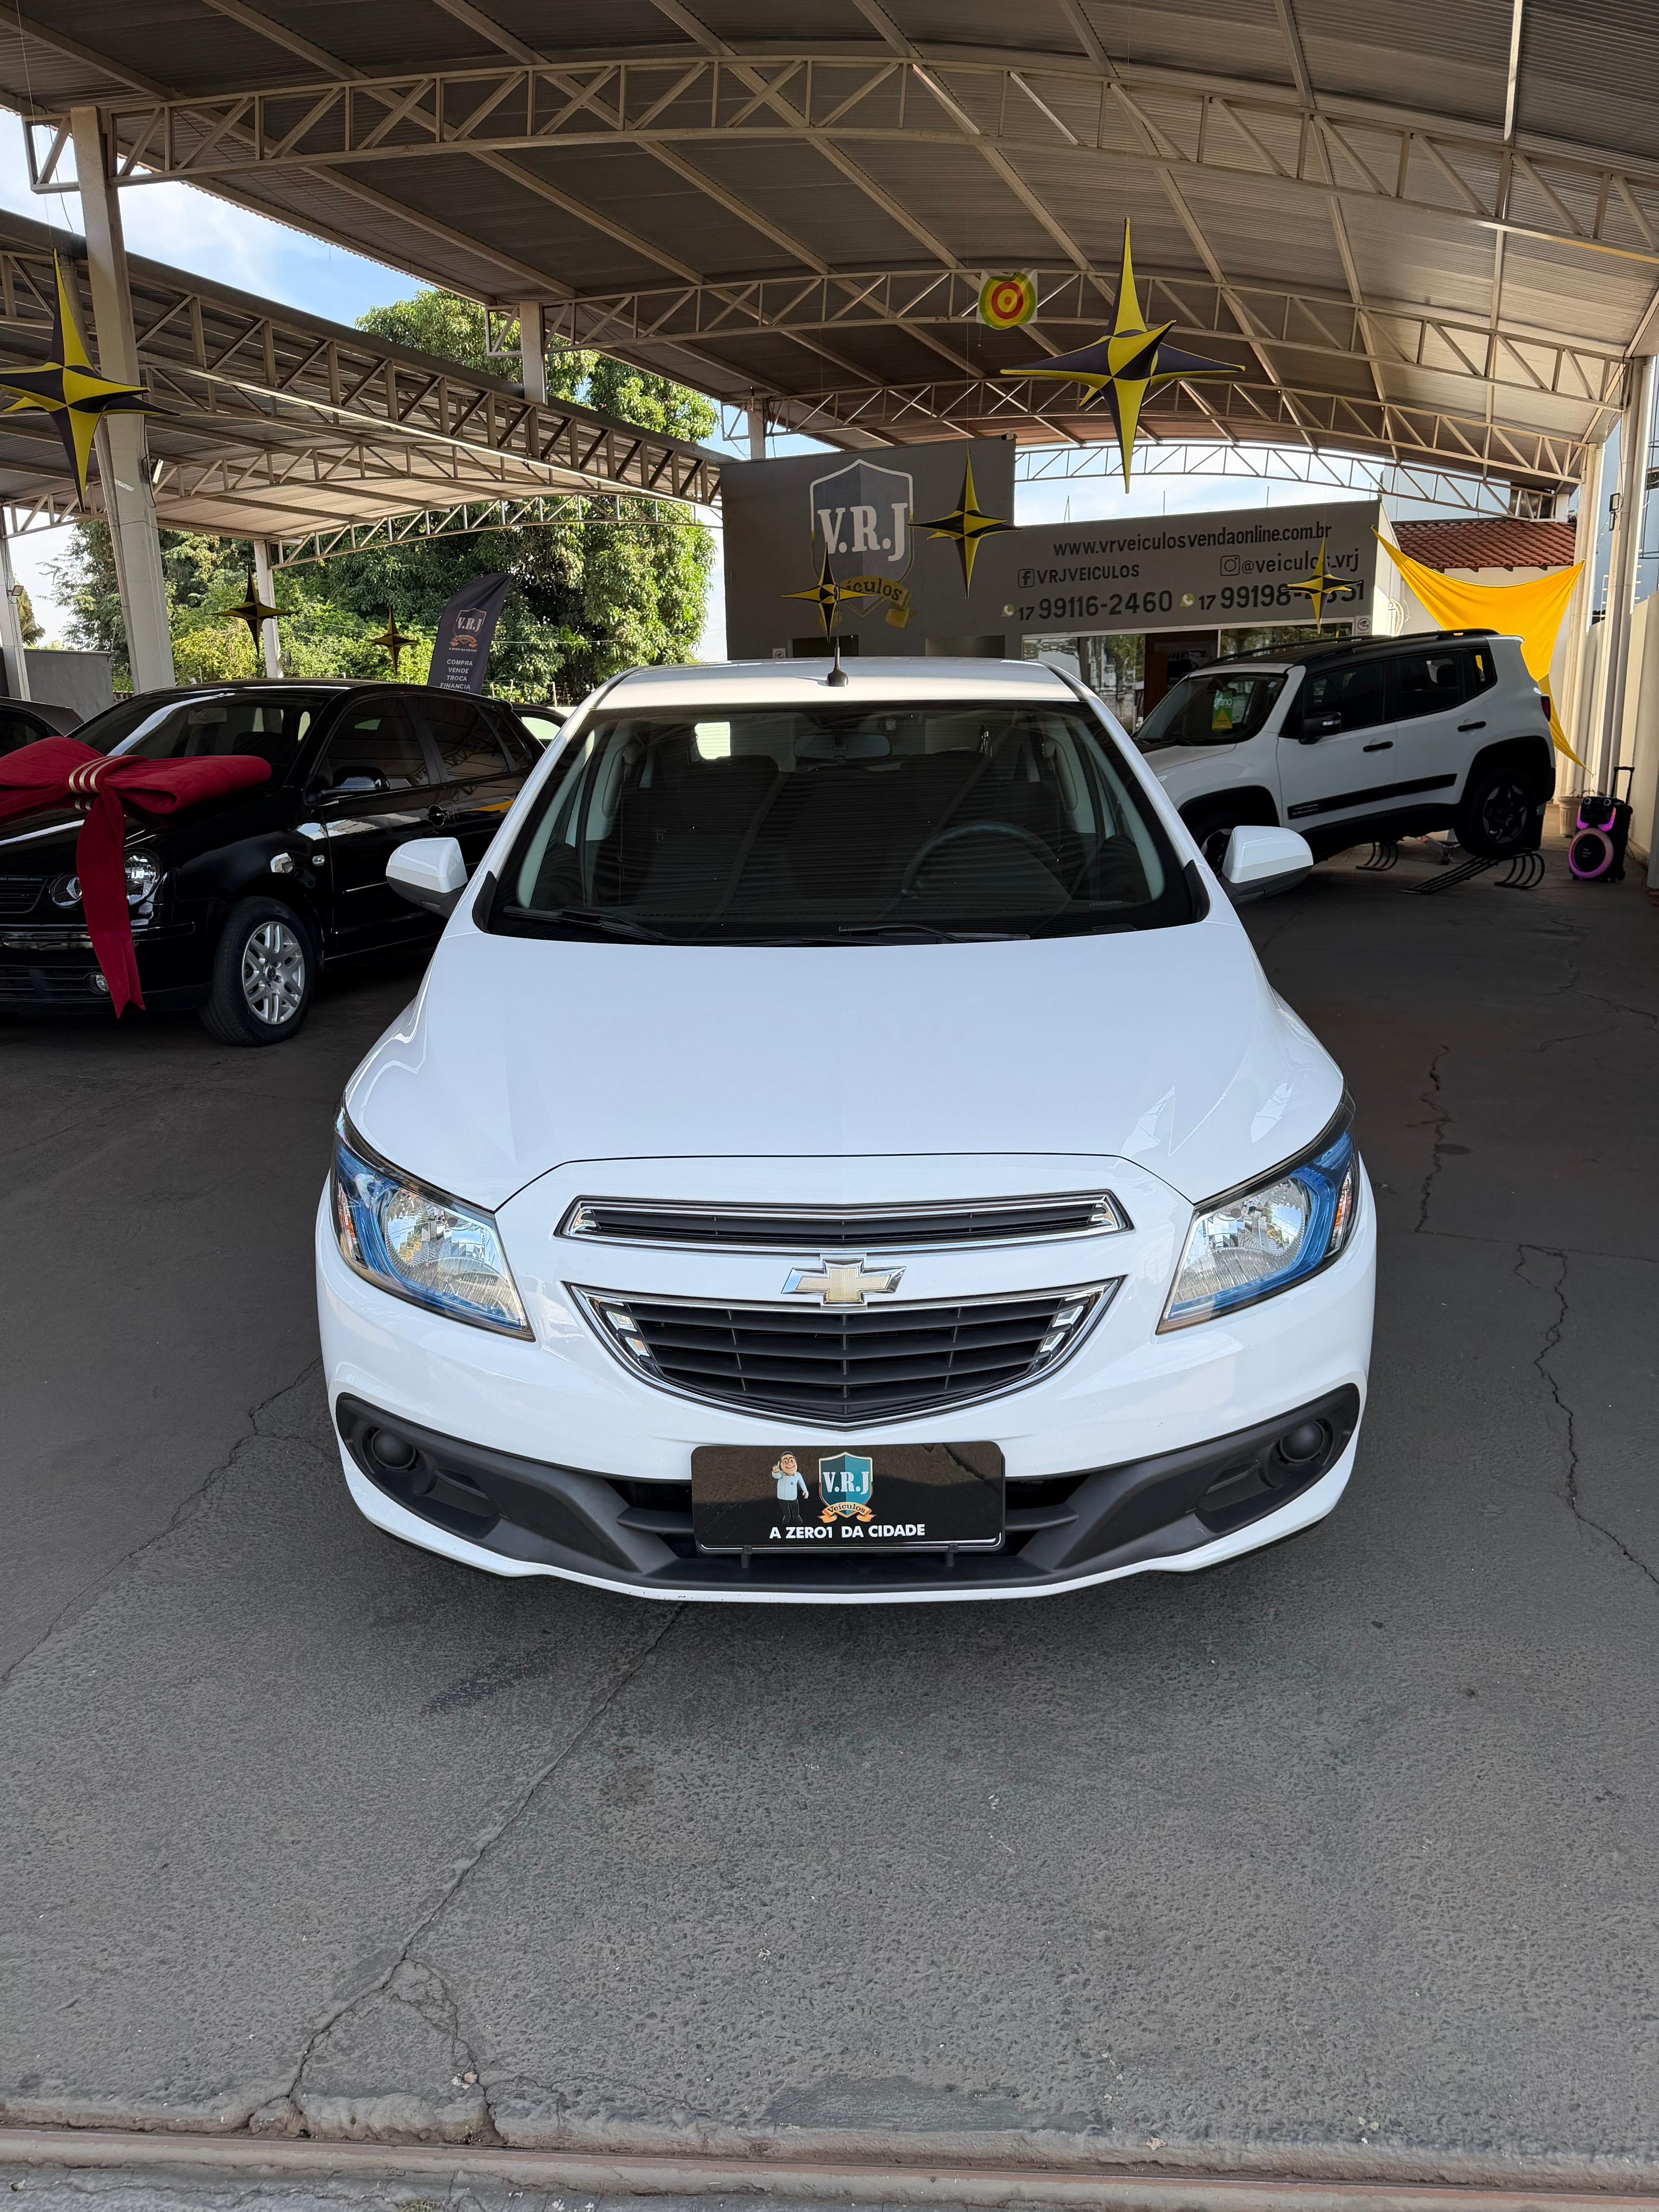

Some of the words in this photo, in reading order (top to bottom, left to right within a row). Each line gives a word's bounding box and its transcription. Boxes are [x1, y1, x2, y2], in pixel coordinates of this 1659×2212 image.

[817, 502, 908, 562] V.R.J
[1053, 521, 1332, 556] www.vrveiculosvendaonline.com.br
[1036, 564, 1140, 584] VRJVEICULOS
[1018, 606, 1035, 621] 17
[1038, 590, 1172, 619] 99116-2460
[1199, 594, 1216, 610] 17
[457, 617, 483, 632] V.R.J
[823, 1471, 869, 1495] V.R.J
[827, 1503, 866, 1513] Veículos
[769, 1527, 782, 1539] A
[785, 1526, 833, 1539] ZERO1
[842, 1526, 864, 1538] DA
[868, 1523, 925, 1538] CIDADE
